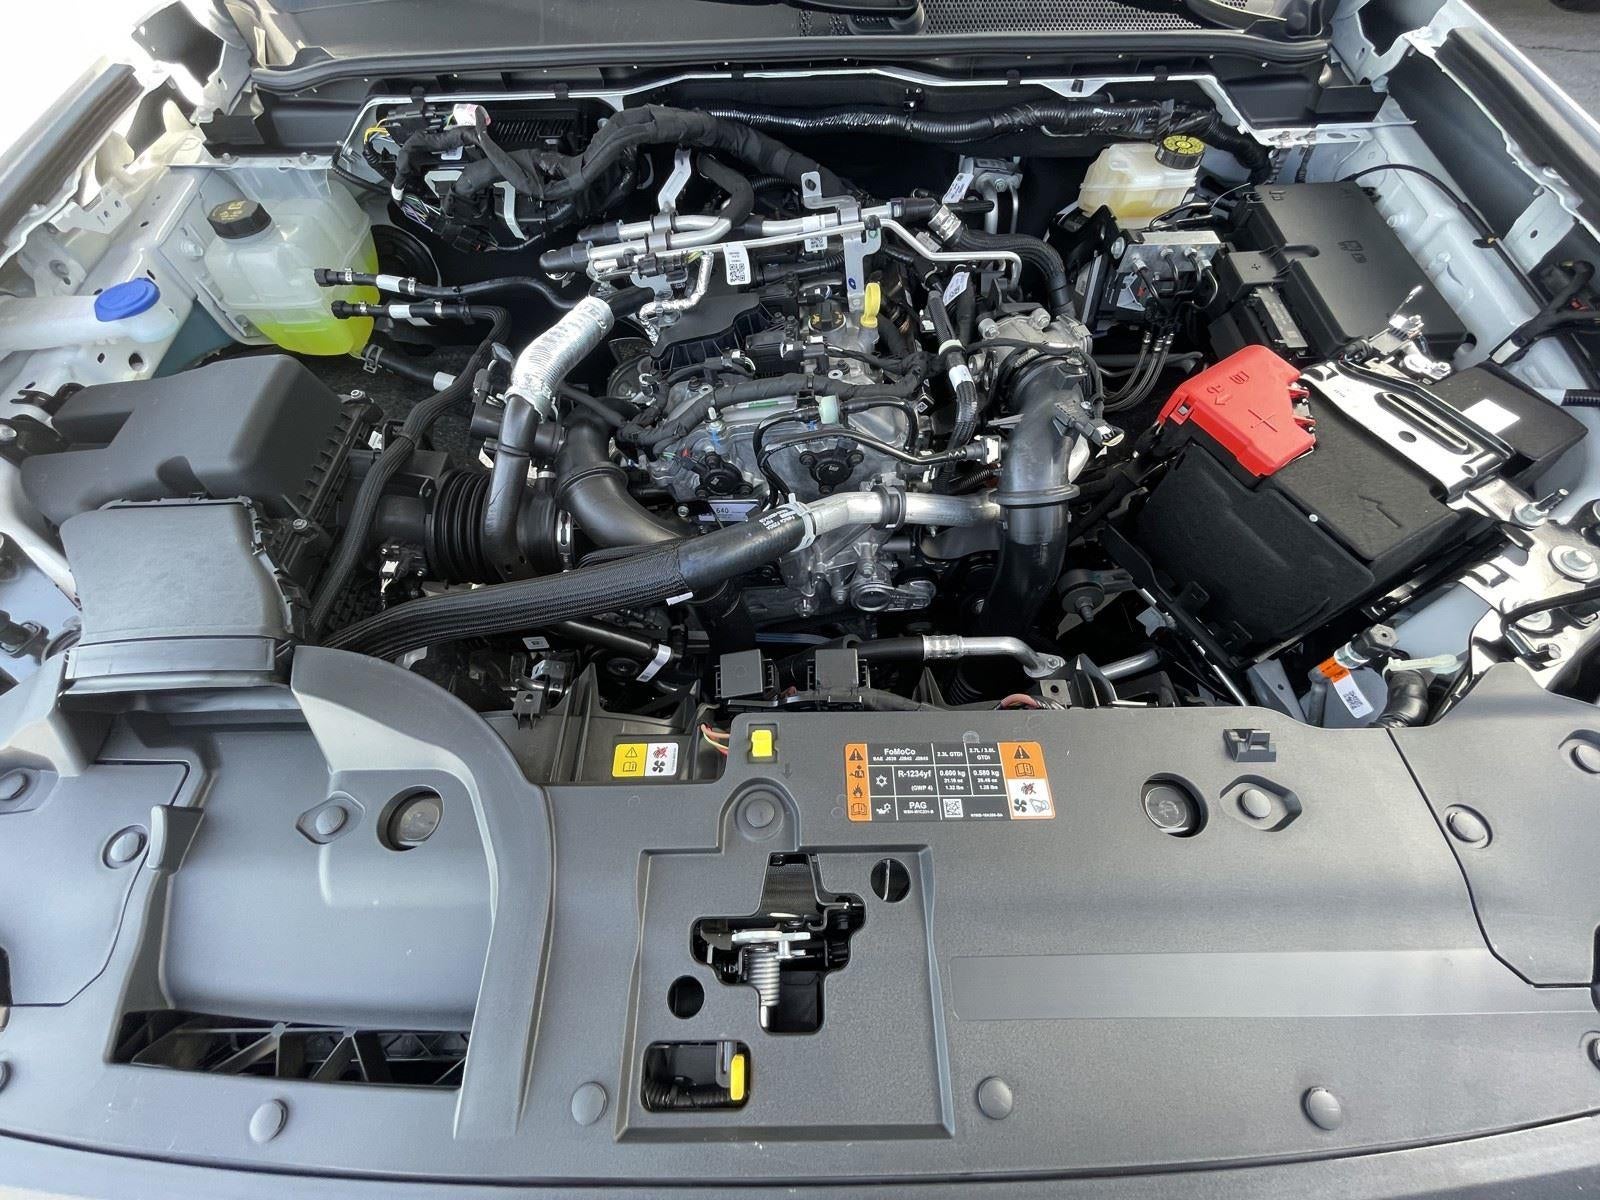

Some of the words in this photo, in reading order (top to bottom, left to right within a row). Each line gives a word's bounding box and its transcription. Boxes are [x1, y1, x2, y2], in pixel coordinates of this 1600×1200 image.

[897, 769, 932, 779] R-1234yf
[957, 770, 966, 778] kg
[990, 769, 1000, 777] kg
[909, 801, 928, 810] PAG
